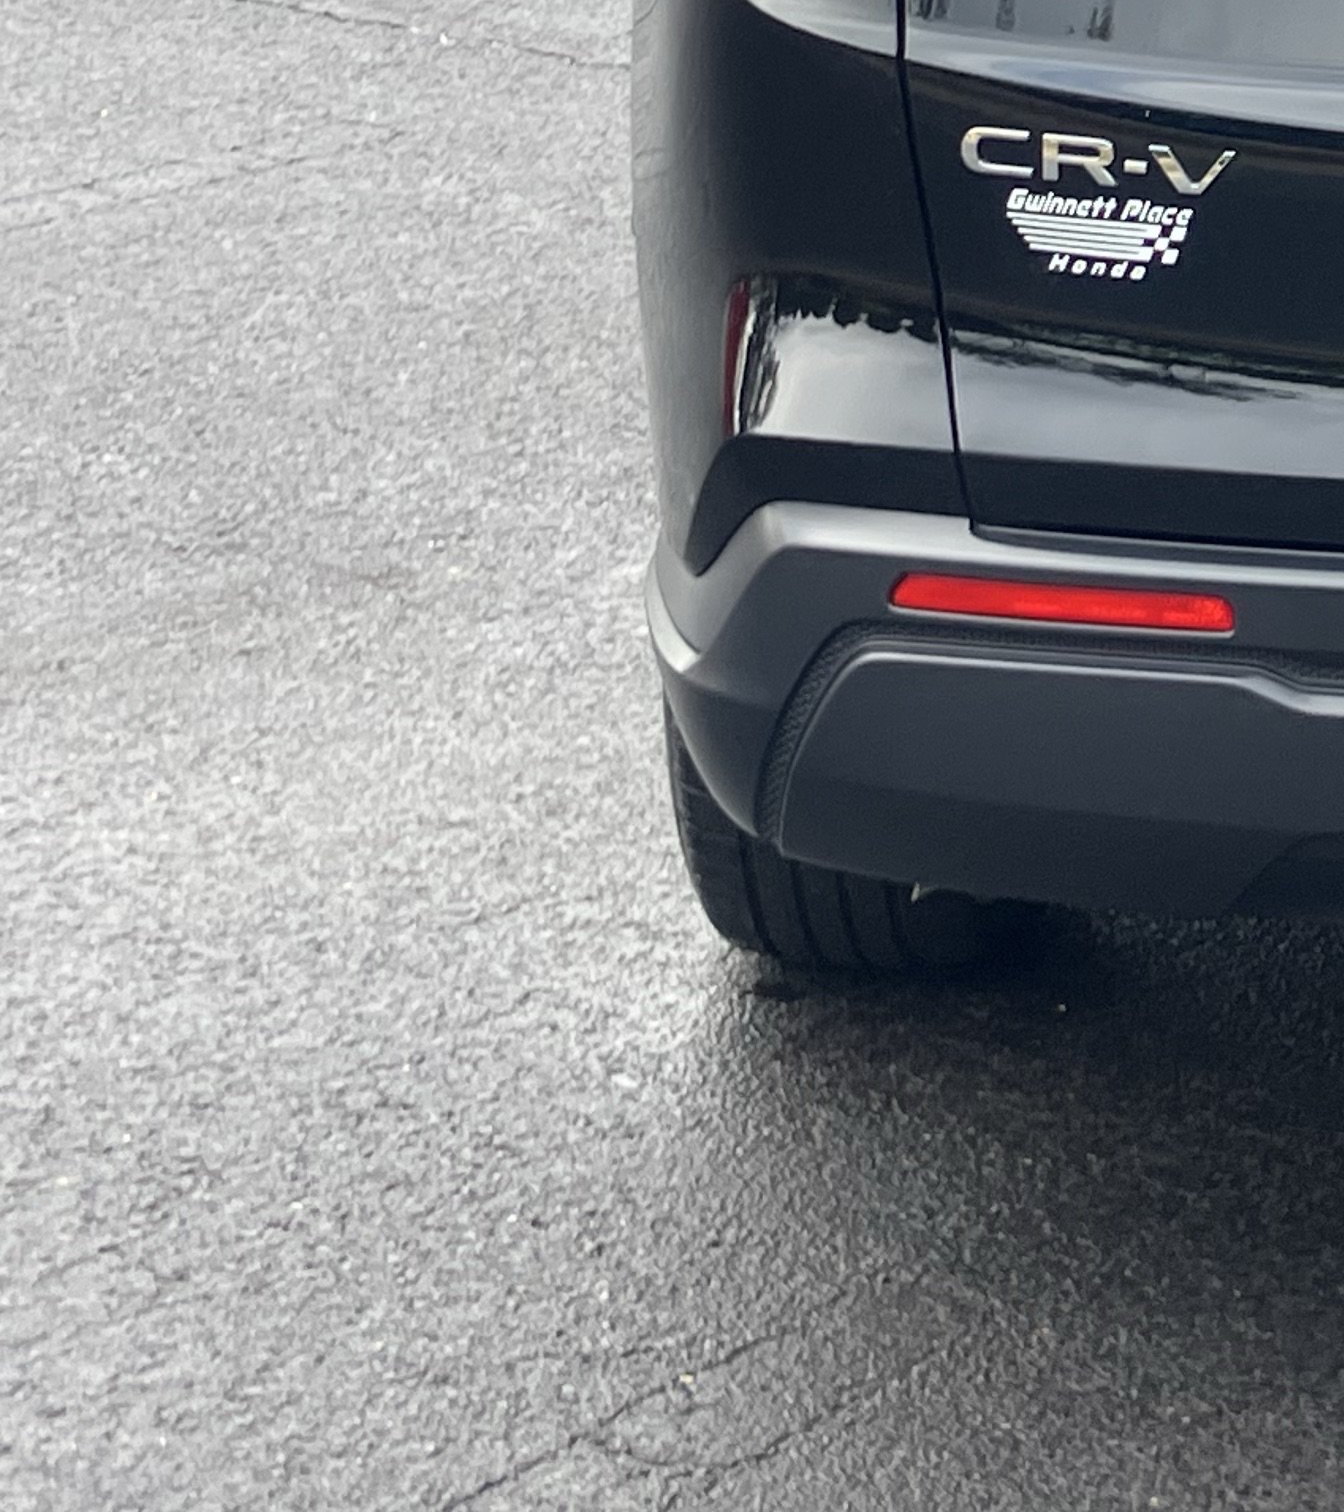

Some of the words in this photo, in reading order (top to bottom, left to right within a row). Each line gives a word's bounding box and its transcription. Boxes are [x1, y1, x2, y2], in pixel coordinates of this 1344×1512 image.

[960, 125, 1238, 196] CR-V
[1006, 188, 1119, 219] Gwinnett
[1120, 198, 1195, 226] Place
[1047, 253, 1148, 281] Honda
